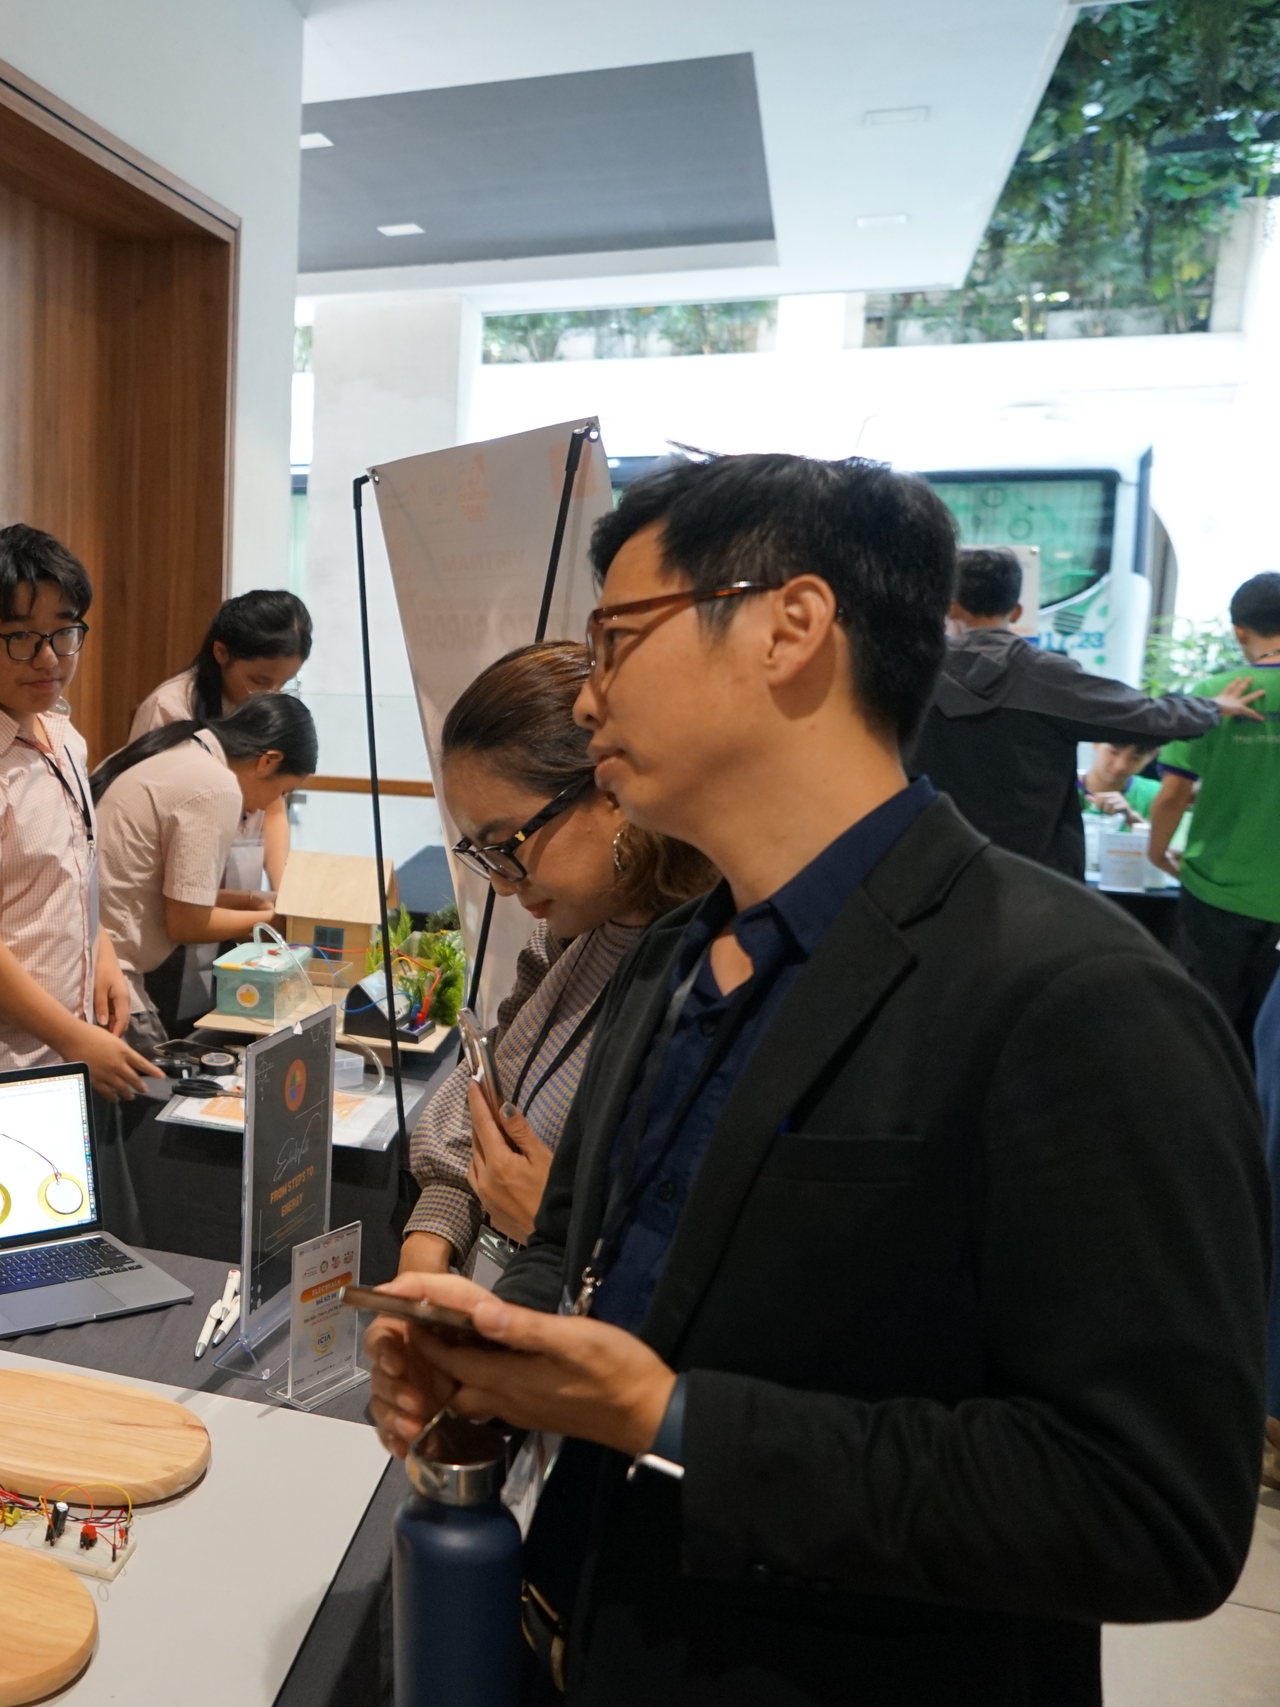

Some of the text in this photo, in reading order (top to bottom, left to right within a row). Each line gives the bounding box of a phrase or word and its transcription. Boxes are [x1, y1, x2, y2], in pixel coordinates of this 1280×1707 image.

[269, 1165, 315, 1204] FROM STEPS TO
[312, 1278, 342, 1296] ELECWALK
[317, 1333, 331, 1345] ICIA
